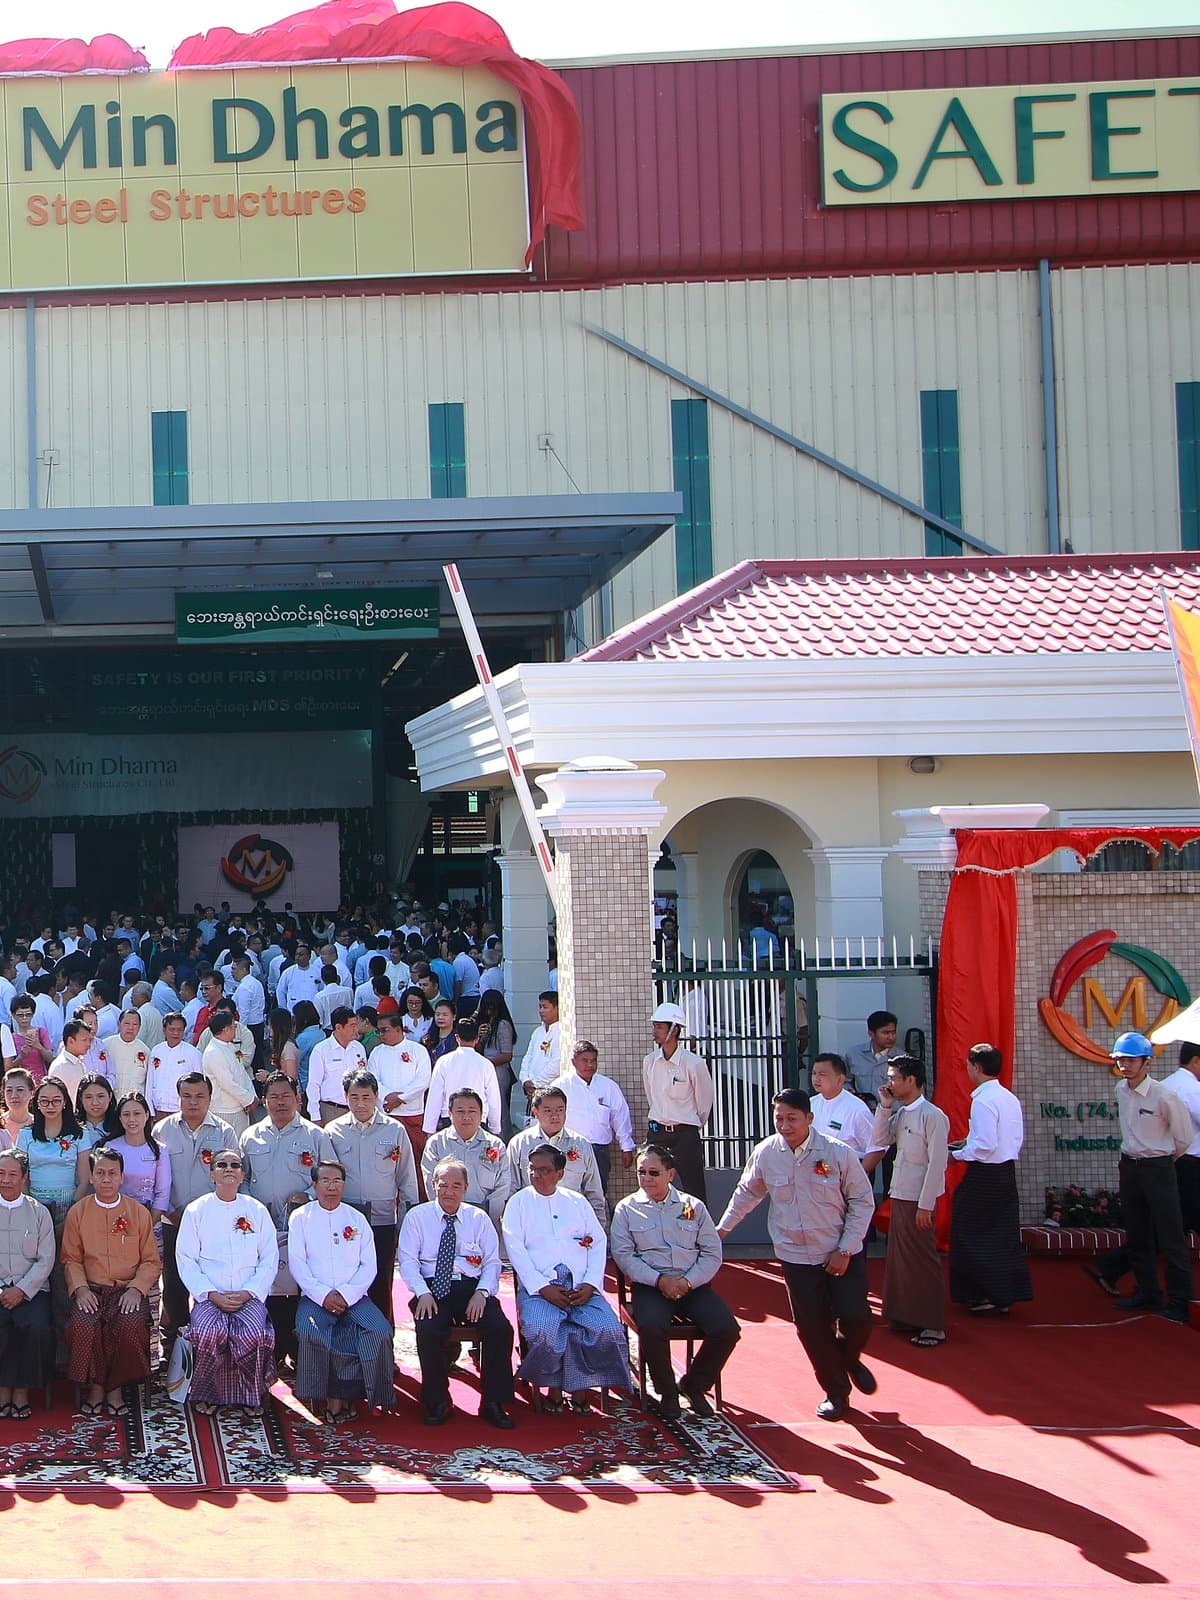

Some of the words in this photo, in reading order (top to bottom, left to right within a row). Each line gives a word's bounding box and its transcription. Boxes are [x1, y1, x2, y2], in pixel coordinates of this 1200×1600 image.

[23, 101, 178, 172] Min
[212, 86, 519, 165] Dhama
[26, 187, 128, 227] Steel
[149, 184, 367, 222] Structures
[91, 672, 161, 686] SAFETY
[167, 671, 184, 685] IS
[188, 671, 224, 685] OUR
[228, 669, 275, 684] FIRST
[283, 667, 367, 682] PRIORITY
[54, 755, 94, 777] Min
[101, 754, 178, 776] Dhama
[1083, 976, 1146, 1029] M
[1040, 1102, 1071, 1119] No.
[1054, 1135, 1123, 1152] Industr
